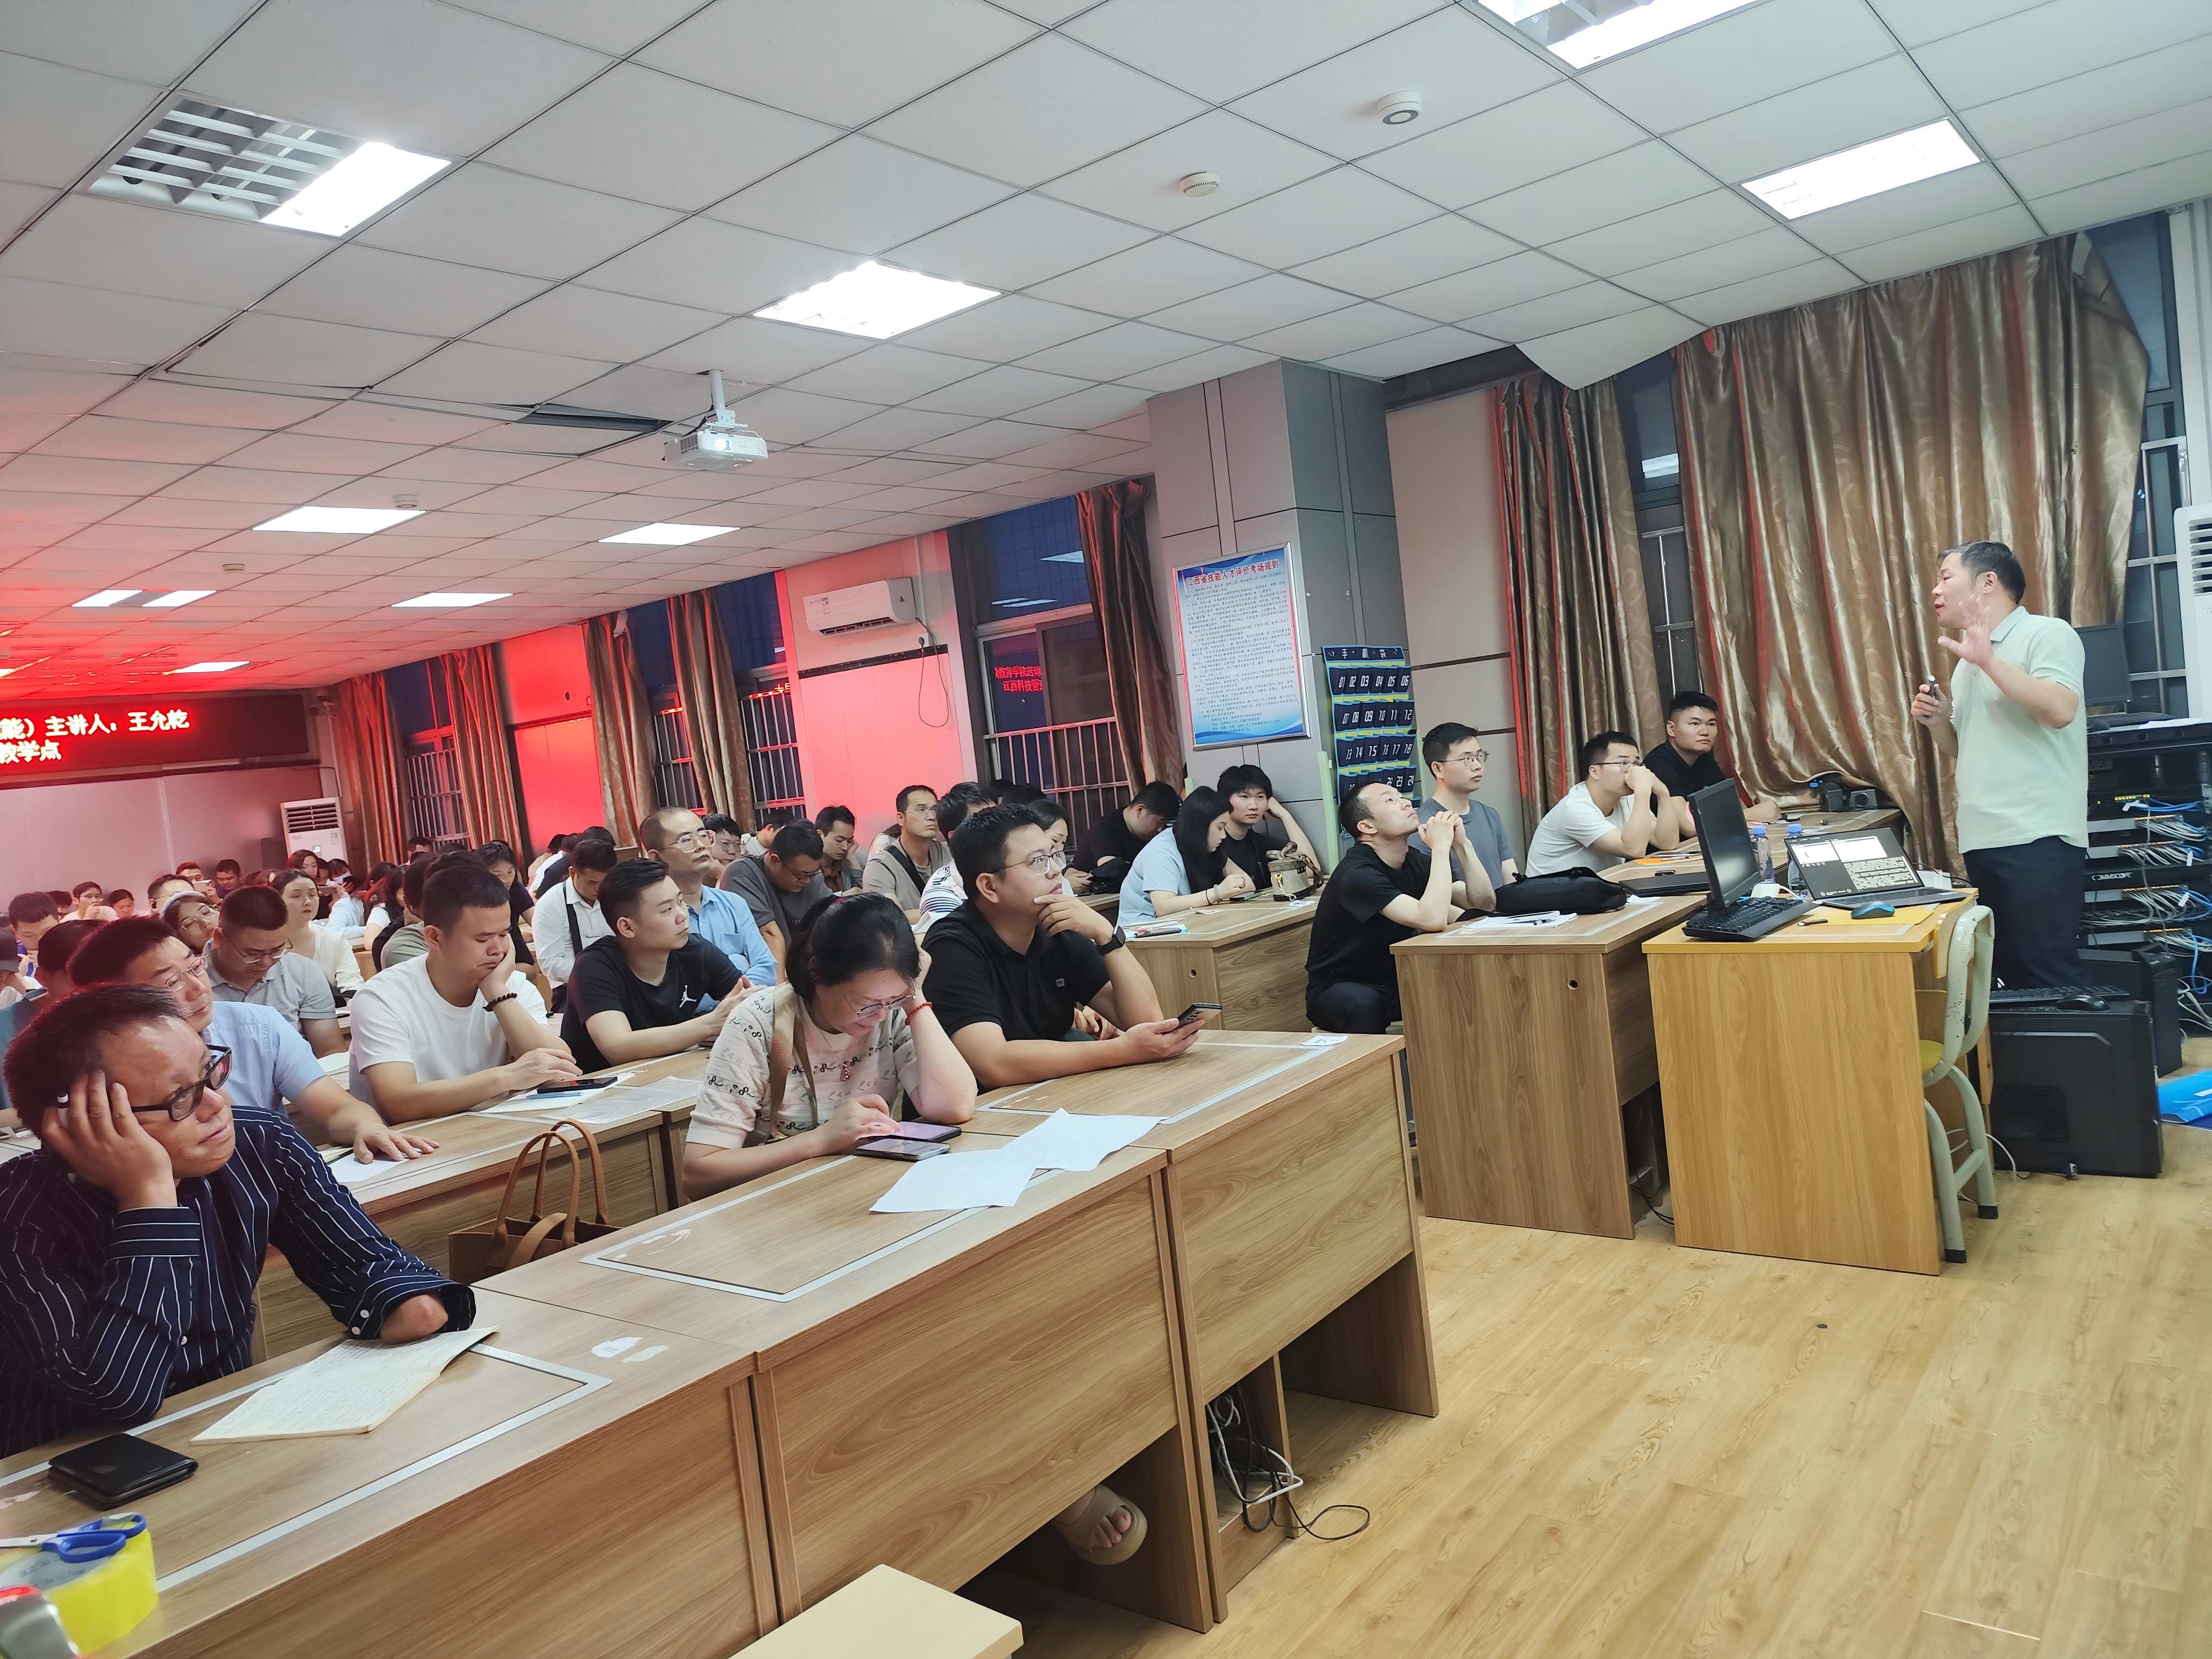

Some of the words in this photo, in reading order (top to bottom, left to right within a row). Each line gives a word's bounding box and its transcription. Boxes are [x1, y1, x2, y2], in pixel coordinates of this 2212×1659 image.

[1186, 558, 1279, 586] 江西省技能人才评价考场规则
[1339, 677, 1346, 688] 01
[1349, 676, 1356, 687] 02
[1360, 676, 1369, 687] 03
[1375, 676, 1384, 687] 04
[1387, 676, 1396, 687] 05
[1401, 676, 1410, 686] 06
[1352, 711, 1359, 723] 08
[1364, 711, 1373, 722] 09
[1379, 710, 1386, 721] 10
[1391, 710, 1397, 721] 11
[1405, 709, 1412, 720] 12
[0, 709, 189, 740] 能）主讲人：王允乾
[1346, 748, 1352, 760] 13
[1356, 747, 1362, 758] 14
[1369, 745, 1378, 757] 15
[1393, 744, 1400, 755] 17
[1404, 743, 1412, 754] 18
[1396, 776, 1403, 787] 23
